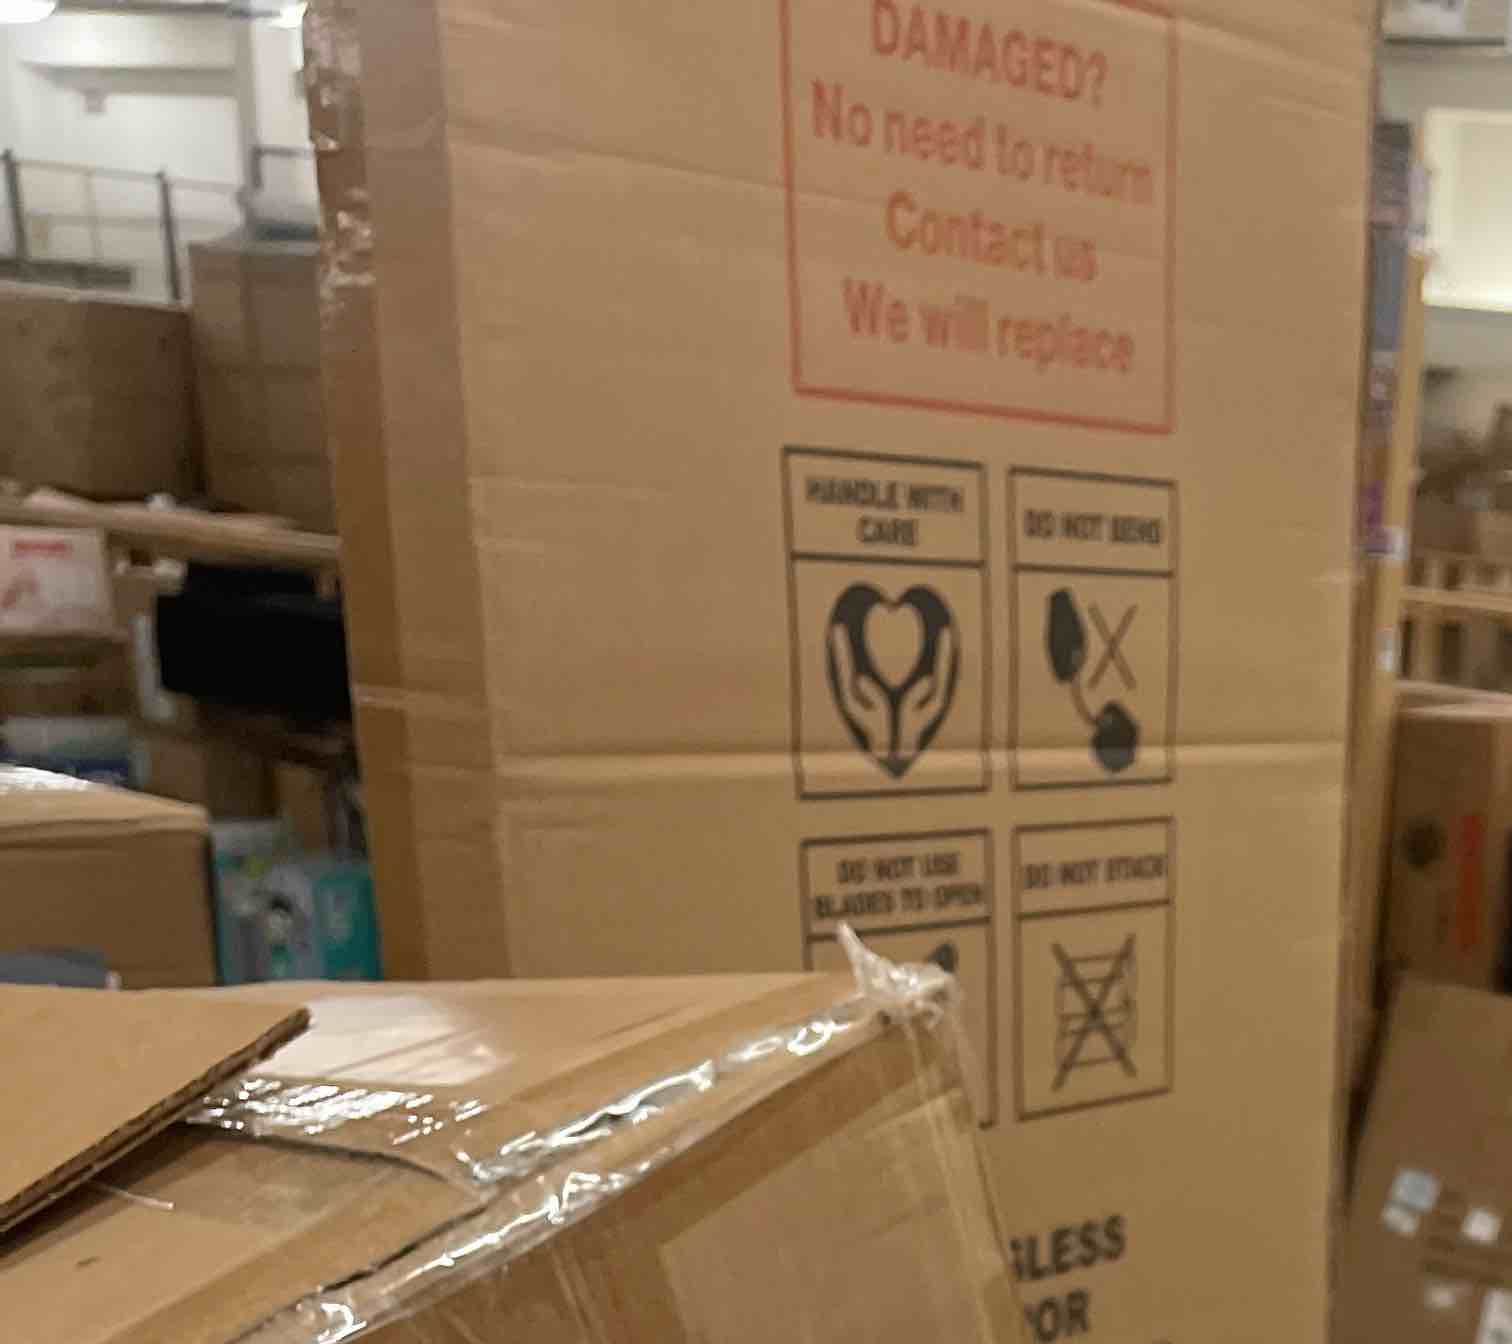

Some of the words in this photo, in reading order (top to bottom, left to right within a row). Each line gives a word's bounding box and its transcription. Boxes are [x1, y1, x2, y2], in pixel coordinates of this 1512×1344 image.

[871, 0, 1108, 104] DAMAGED?
[811, 79, 872, 147] No
[883, 110, 985, 172] need
[995, 124, 1034, 183] to
[1045, 143, 1155, 206] return
[885, 190, 1046, 275] Contact
[1053, 232, 1097, 283] us
[842, 277, 909, 344] We
[918, 292, 989, 354] will
[997, 315, 1135, 375] replace
[1024, 1287, 1090, 1344] OR
